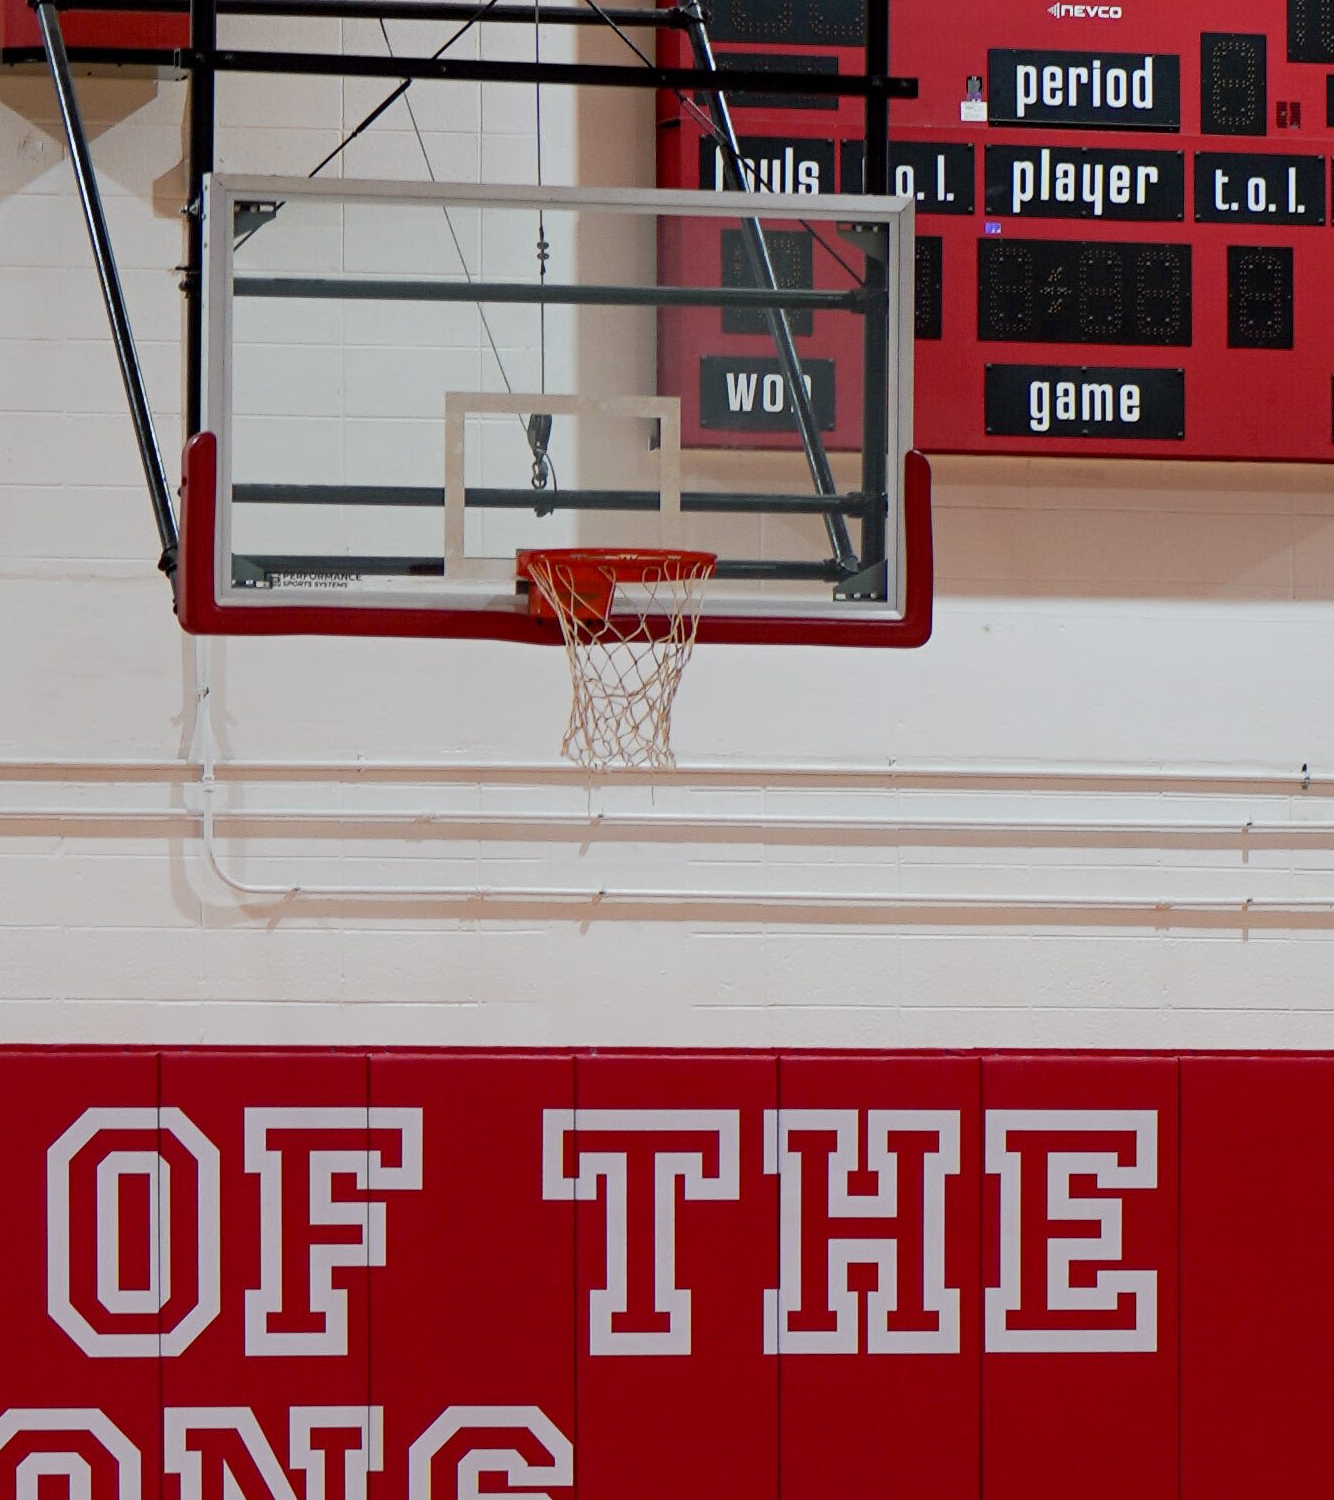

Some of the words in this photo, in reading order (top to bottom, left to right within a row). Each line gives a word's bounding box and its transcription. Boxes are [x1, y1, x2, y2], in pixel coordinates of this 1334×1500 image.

[1016, 56, 1154, 117] period
[1012, 148, 1159, 216] player
[1029, 380, 1142, 432] game
[47, 1107, 423, 1358] OF
[542, 1108, 1158, 1356] THE
